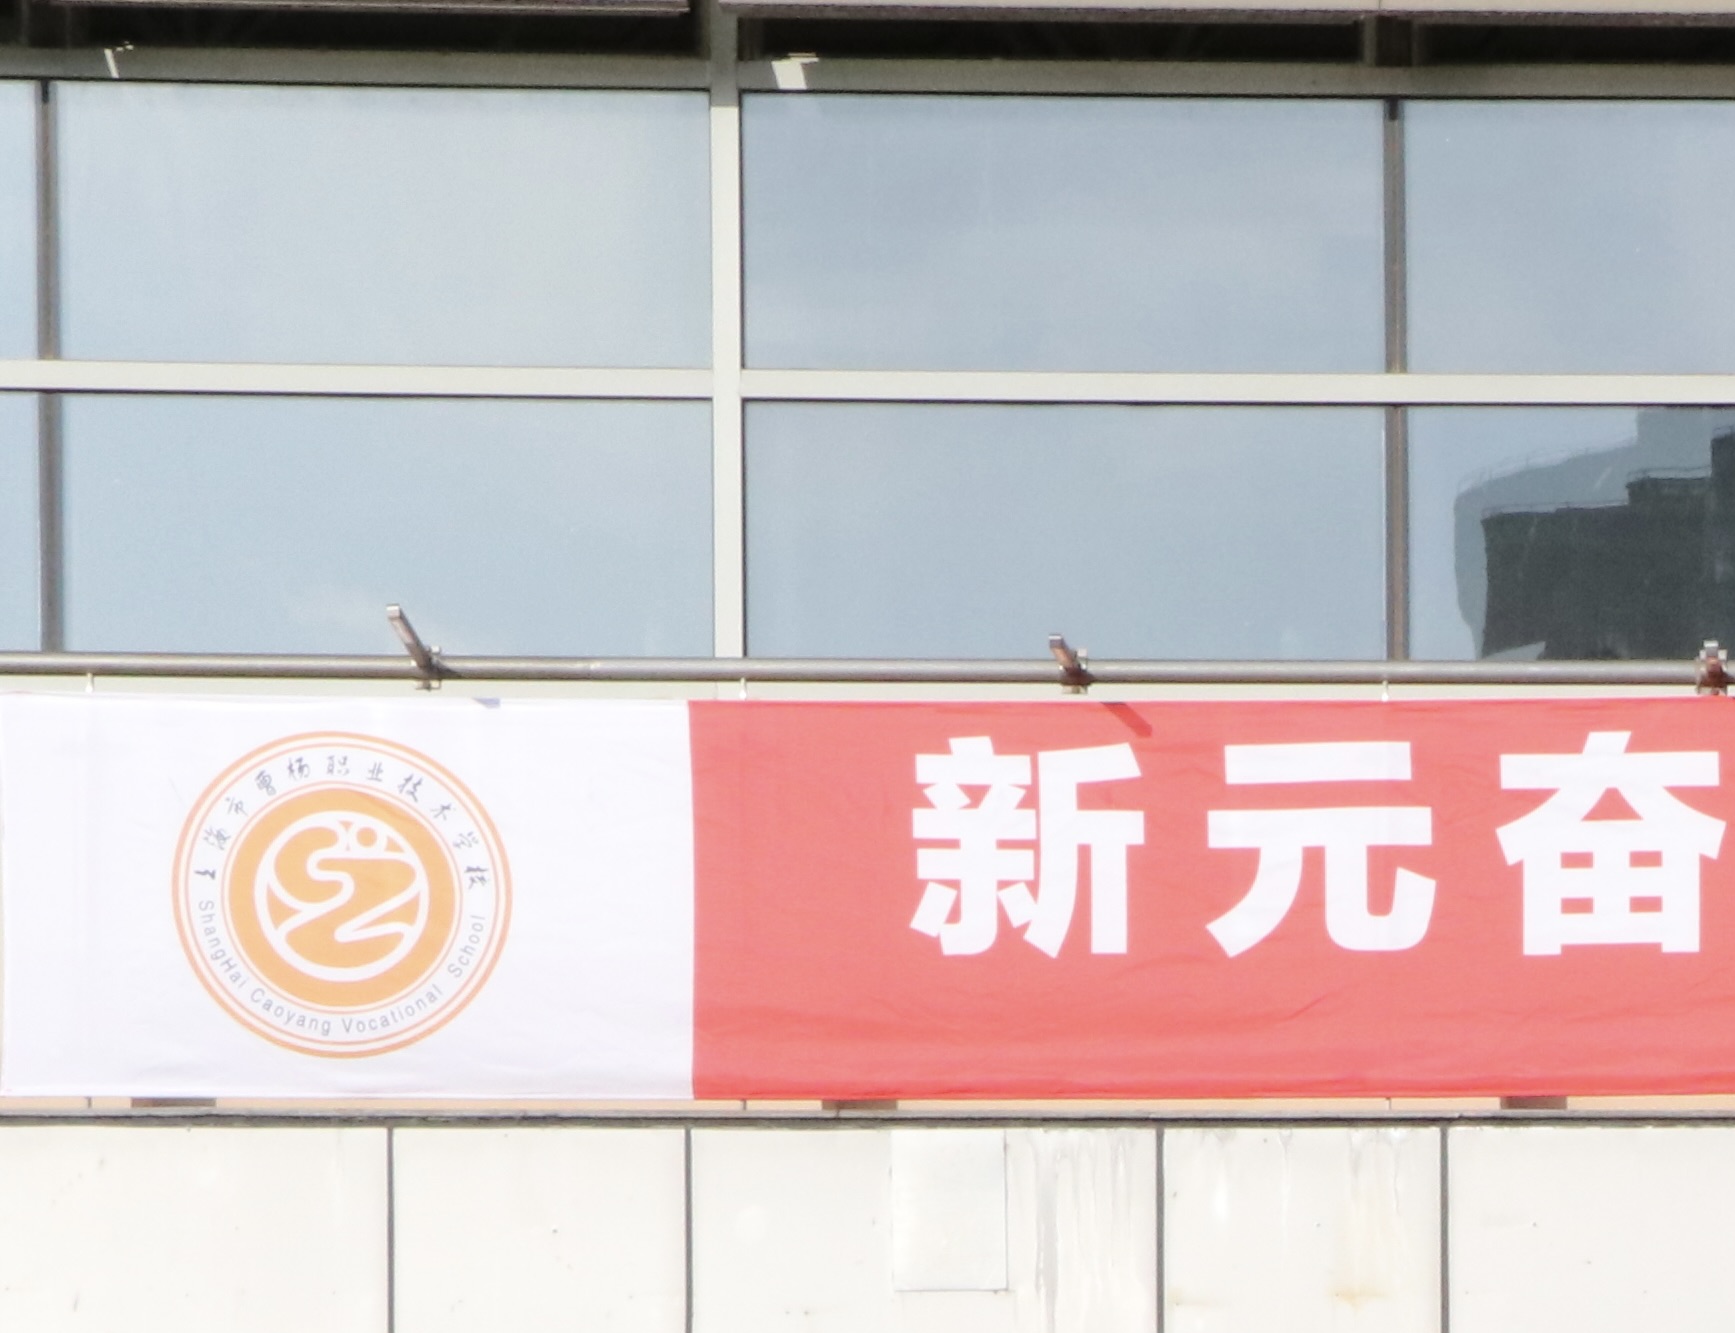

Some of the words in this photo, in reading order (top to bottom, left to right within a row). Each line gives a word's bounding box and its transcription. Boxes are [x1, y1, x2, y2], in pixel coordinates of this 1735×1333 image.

[249, 986, 332, 1036] Caoyang
[341, 983, 444, 1034] Vocational
[447, 914, 487, 979] School
